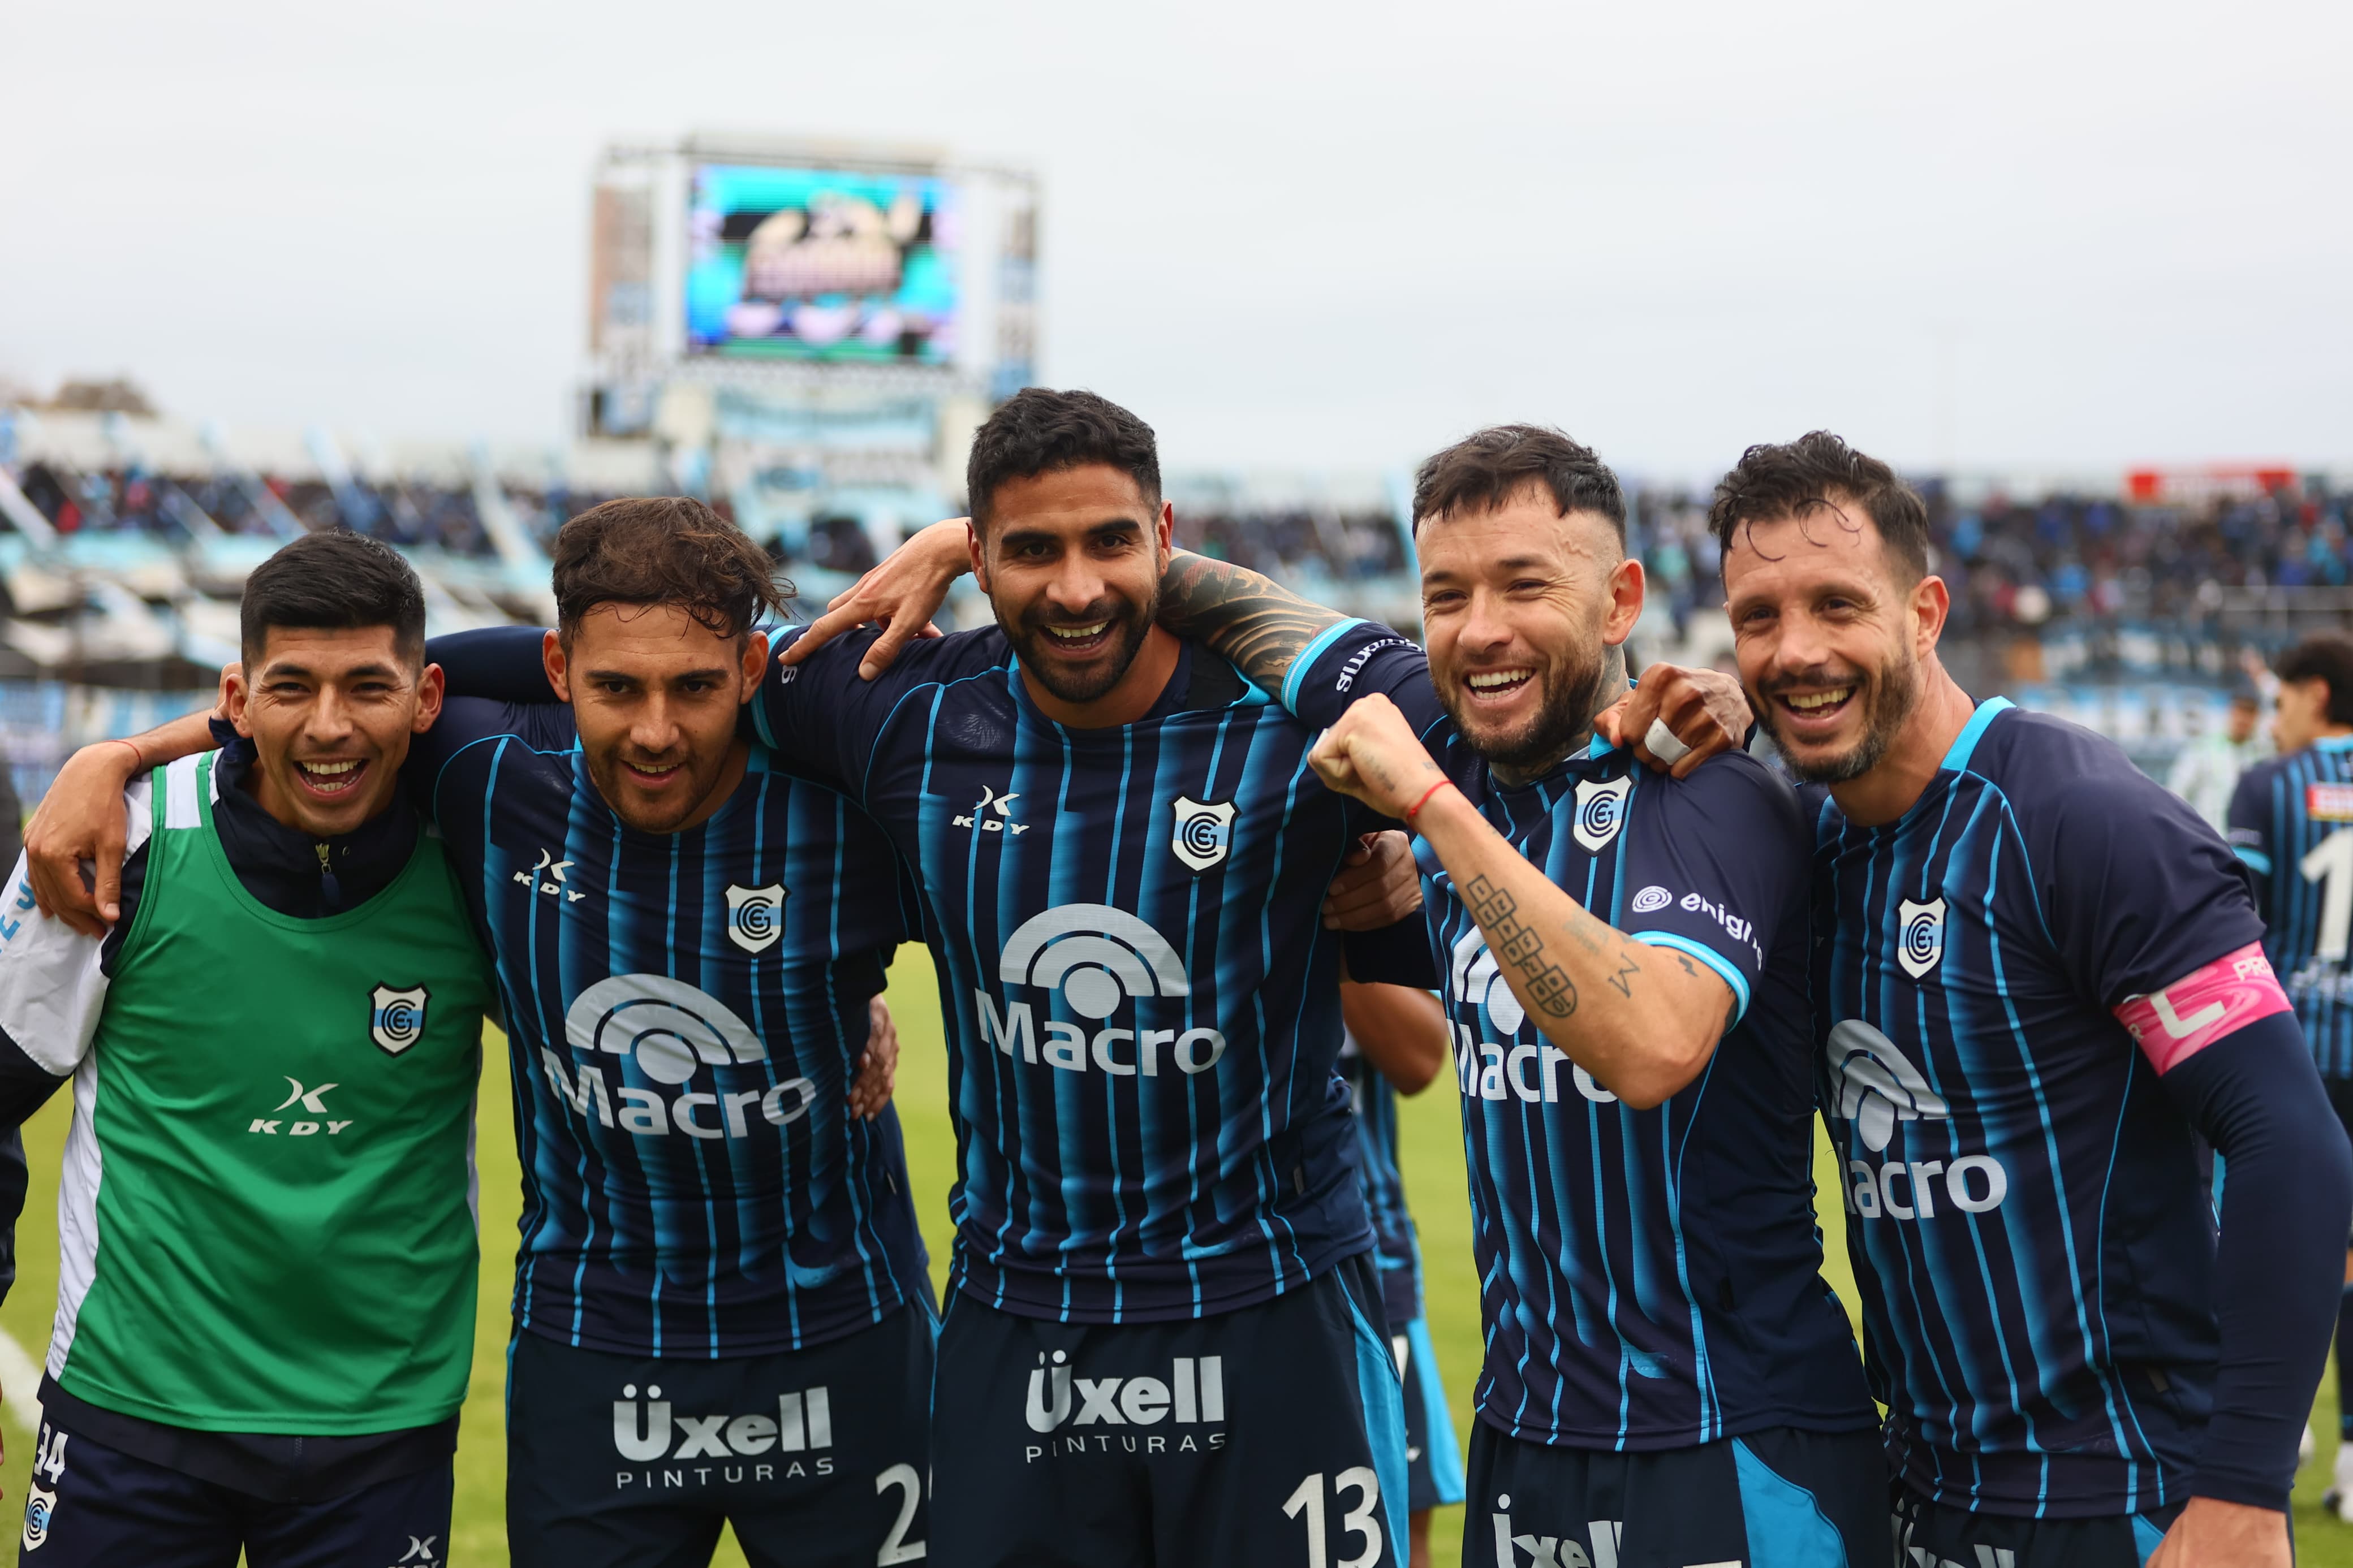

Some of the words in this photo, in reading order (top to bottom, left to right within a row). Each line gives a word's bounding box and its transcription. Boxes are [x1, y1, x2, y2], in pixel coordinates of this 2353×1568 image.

[952, 814, 1030, 835] KDY
[513, 871, 585, 902] KDY
[975, 987, 1226, 1077] Macro
[541, 1044, 816, 1139] Macro
[248, 1119, 354, 1135] KDY
[1025, 1350, 1225, 1433] Üxell
[614, 1384, 833, 1462] Üxell
[1026, 1433, 1226, 1463] PINTURAS
[617, 1457, 834, 1489] PINTURAS
[1282, 1466, 1383, 1568] 13
